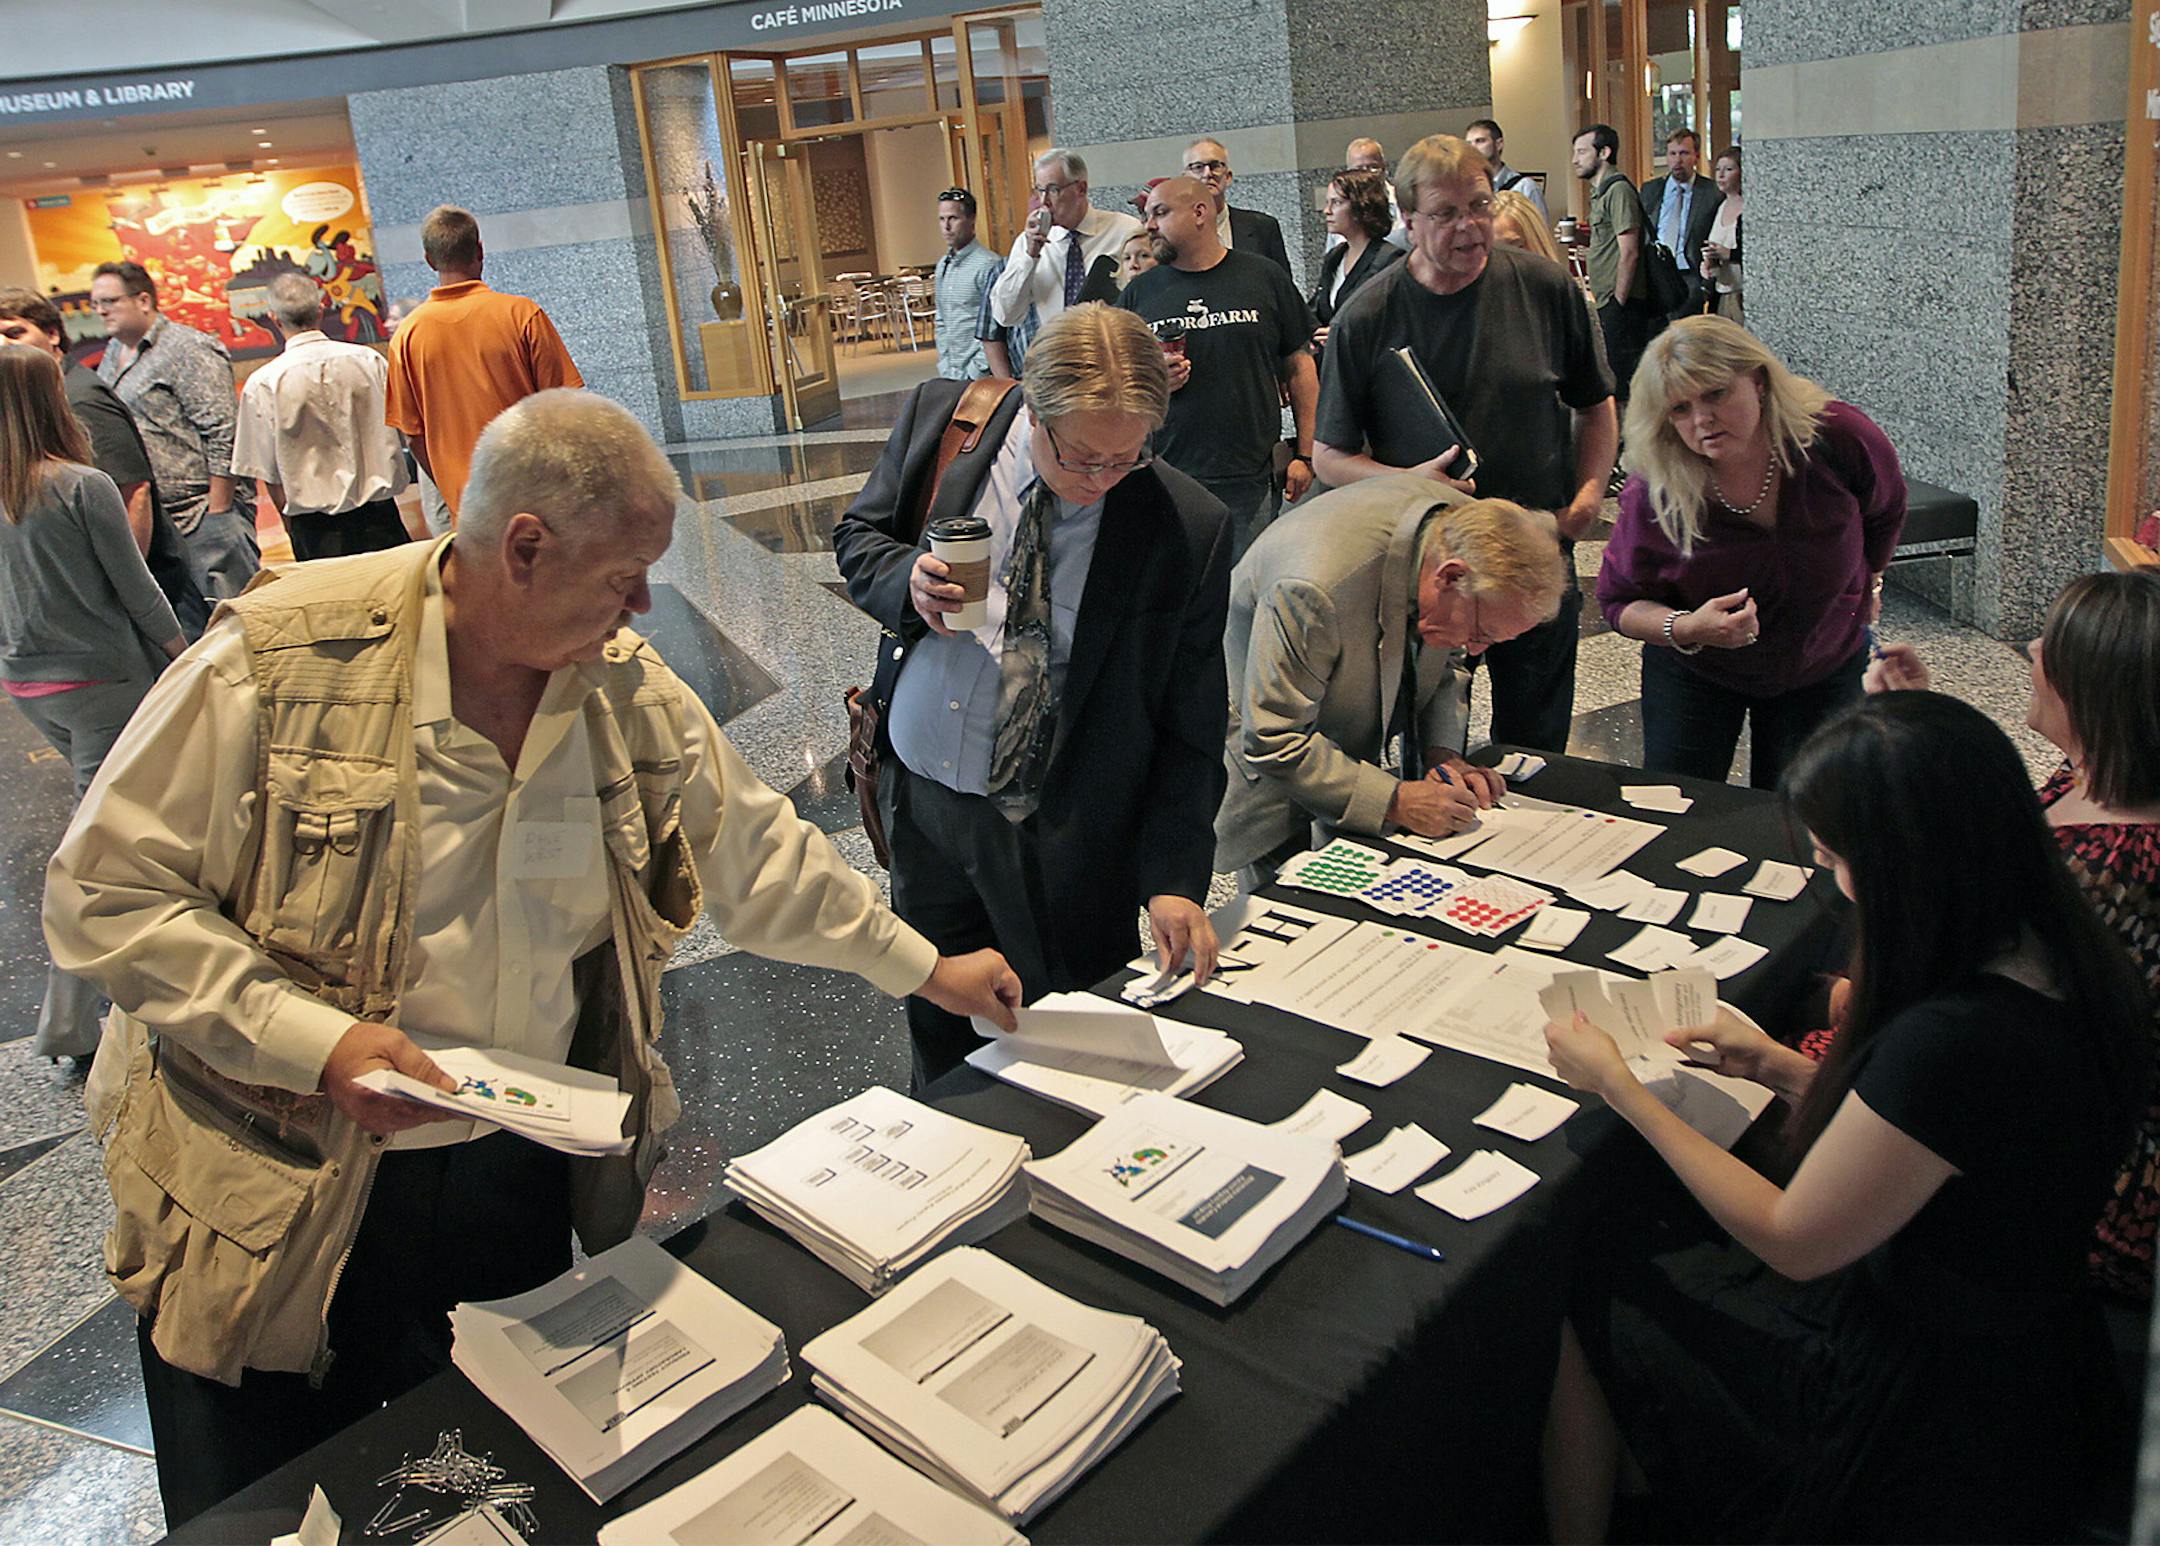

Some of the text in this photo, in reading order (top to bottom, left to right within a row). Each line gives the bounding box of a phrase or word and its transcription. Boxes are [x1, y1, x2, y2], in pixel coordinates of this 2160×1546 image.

[751, 0, 903, 31] CAFÉ MINNESOTA
[85, 88, 101, 107] &
[104, 80, 195, 105] LIBRARY
[1146, 308, 1259, 335] DROFARM
